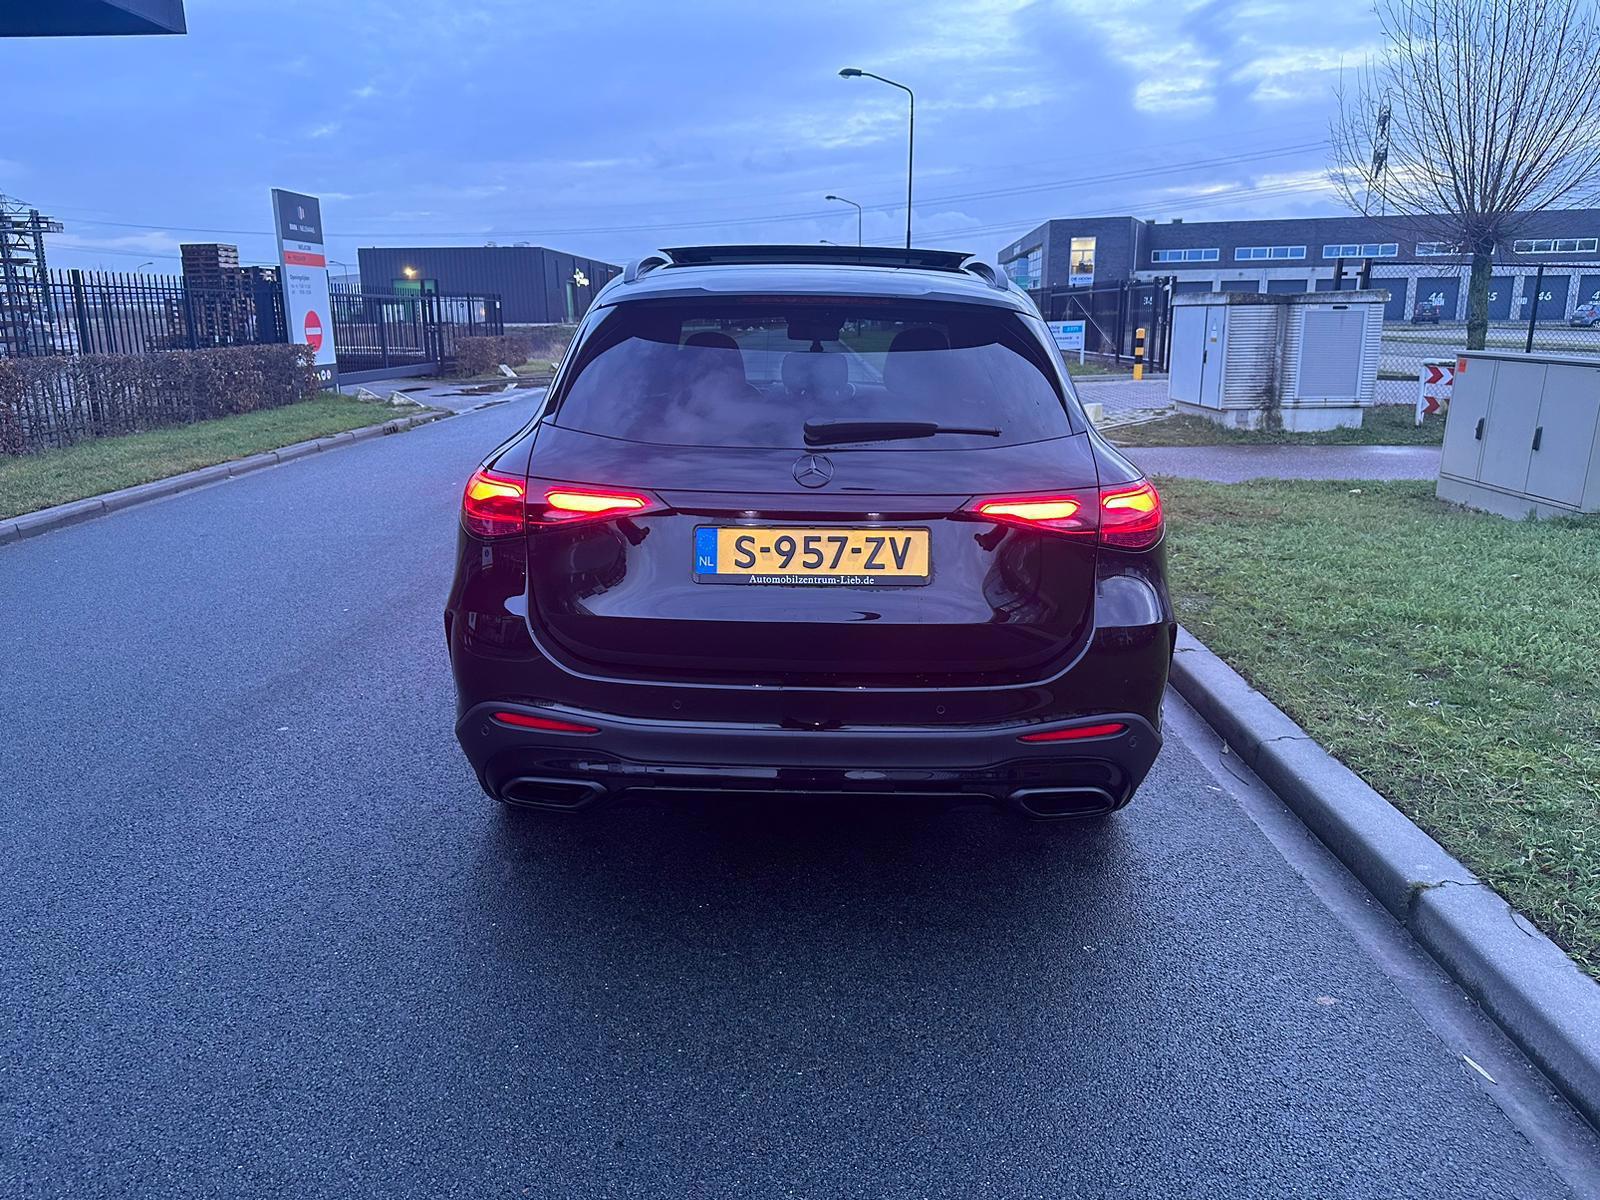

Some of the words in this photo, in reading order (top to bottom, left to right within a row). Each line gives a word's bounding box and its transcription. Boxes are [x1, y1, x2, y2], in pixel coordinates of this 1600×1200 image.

[734, 535, 911, 570] S-957-ZV
[699, 556, 714, 567] NL
[749, 574, 874, 585] Automobilzentrum-Lieb.de
